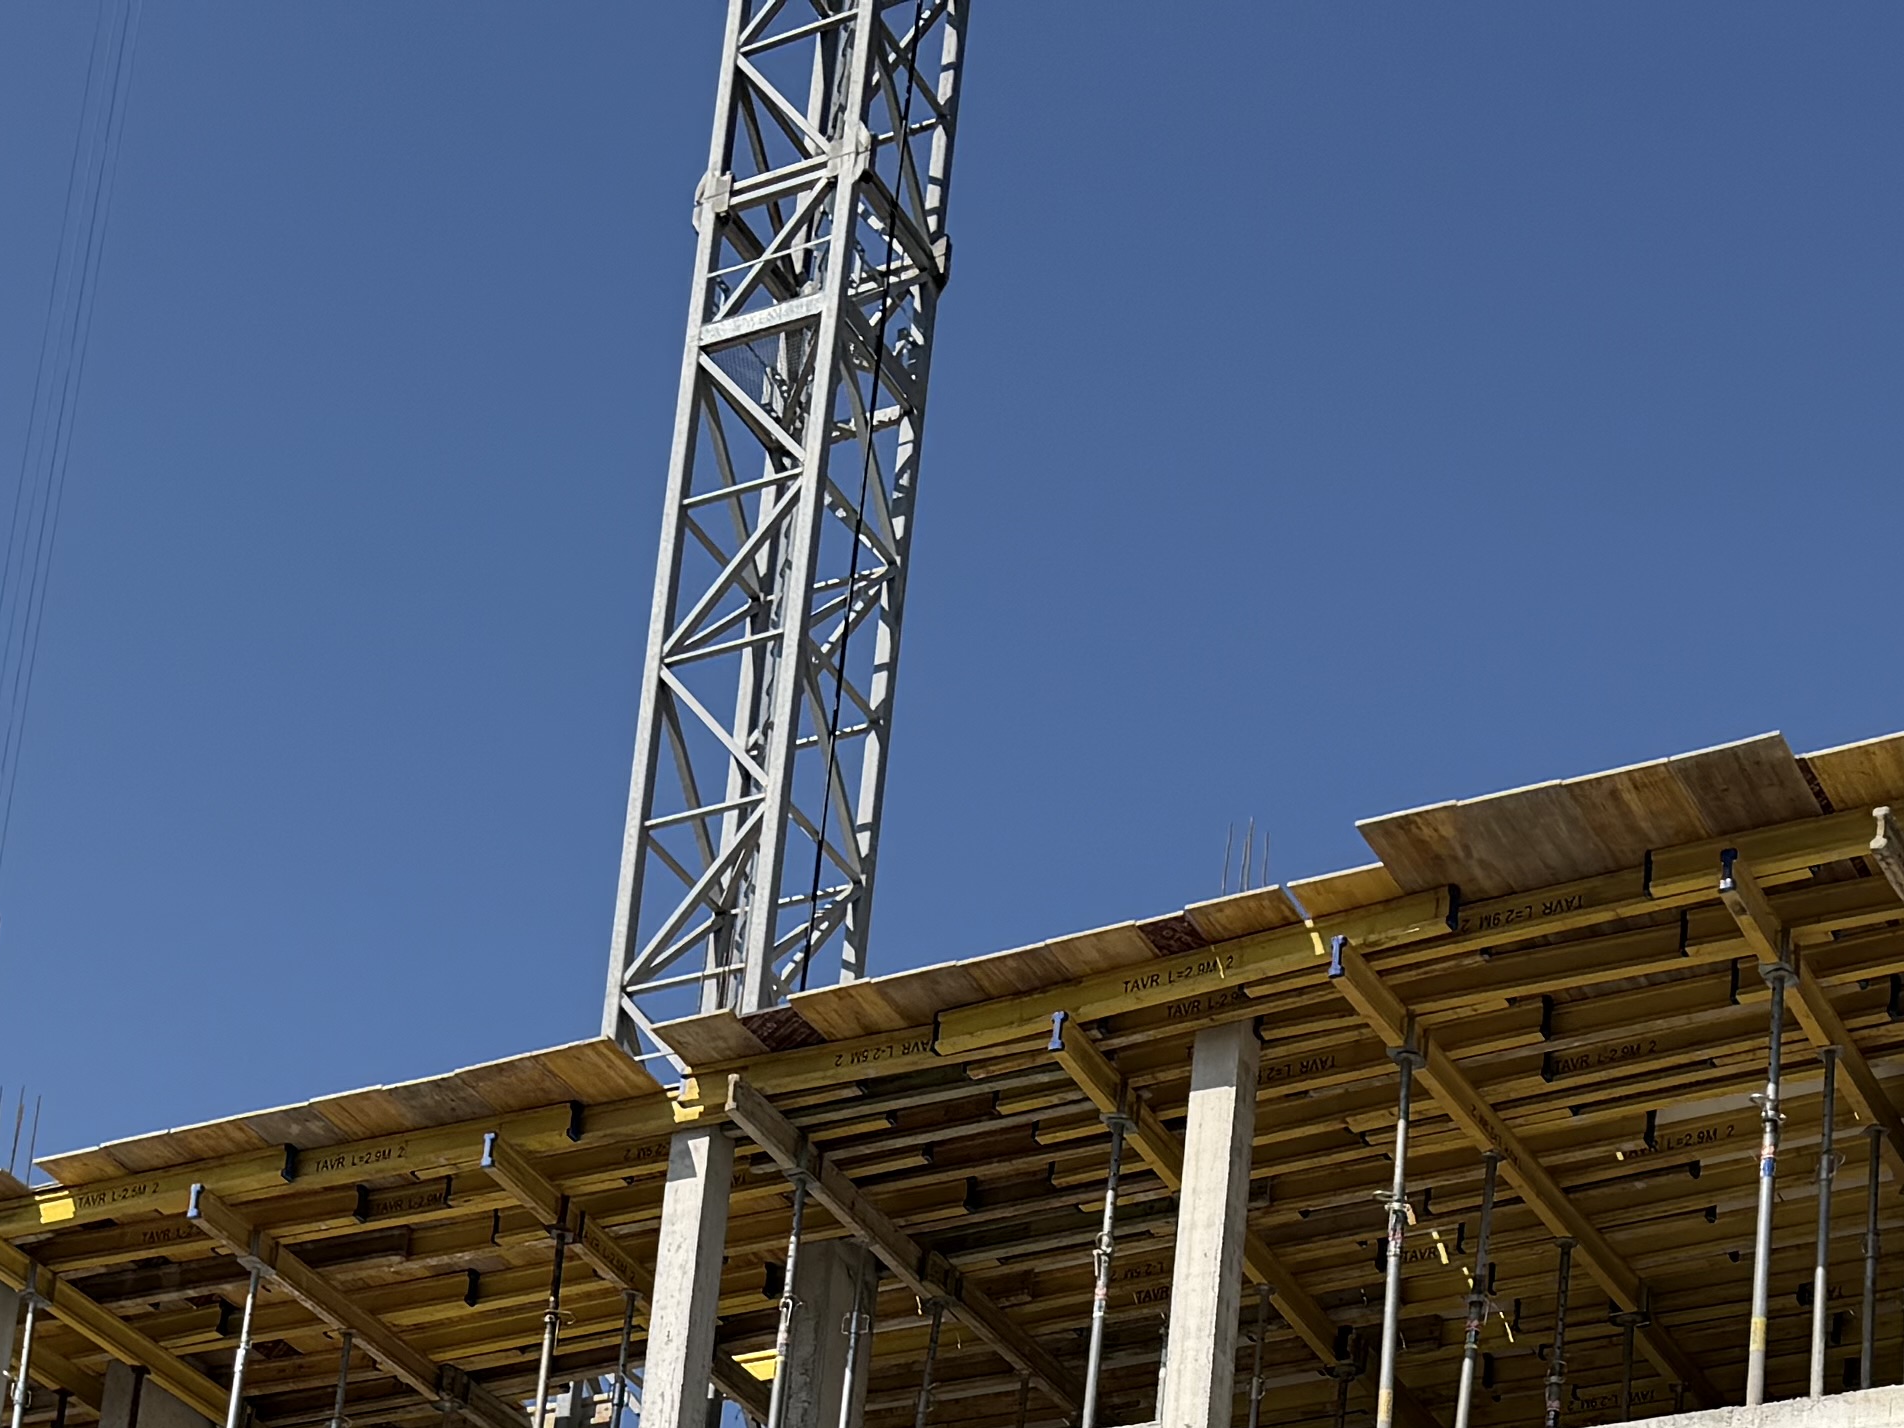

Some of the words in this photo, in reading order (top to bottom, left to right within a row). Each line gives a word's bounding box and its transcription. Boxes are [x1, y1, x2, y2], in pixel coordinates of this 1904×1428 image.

[1542, 896, 1584, 916] TAVR
[1123, 974, 1160, 994] TAVR
[1226, 956, 1234, 969] 2
[1166, 1001, 1201, 1018] TAVR
[902, 1039, 932, 1056] AVR
[1299, 1056, 1338, 1074] TAVR
[1554, 1054, 1589, 1075] TAVR
[315, 1156, 345, 1173] TAVR
[77, 1191, 107, 1208] TAVR
